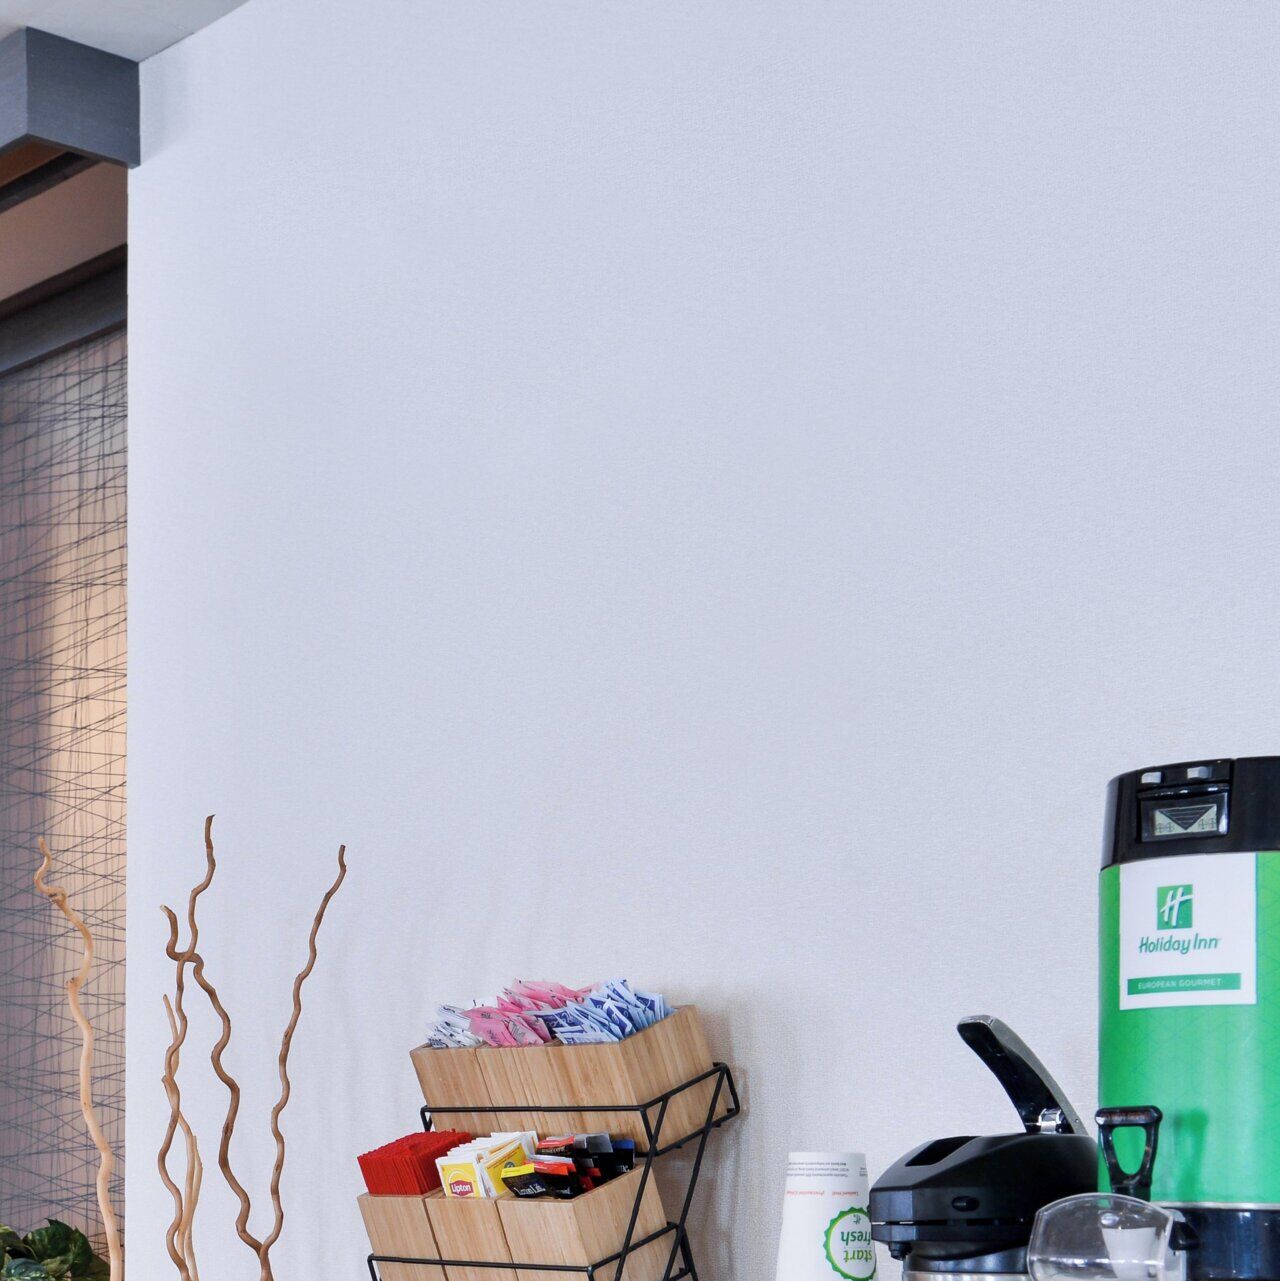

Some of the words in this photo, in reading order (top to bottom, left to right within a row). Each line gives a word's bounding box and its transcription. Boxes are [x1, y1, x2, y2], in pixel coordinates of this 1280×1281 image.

[1138, 935, 1191, 955] Holiday
[1193, 933, 1219, 950] Inn
[1138, 980, 1177, 990] EUROPEAN
[1179, 978, 1222, 988] GOURMET
[451, 1183, 472, 1194] Lipton
[840, 1231, 872, 1246] fresh
[843, 1249, 873, 1263] start
